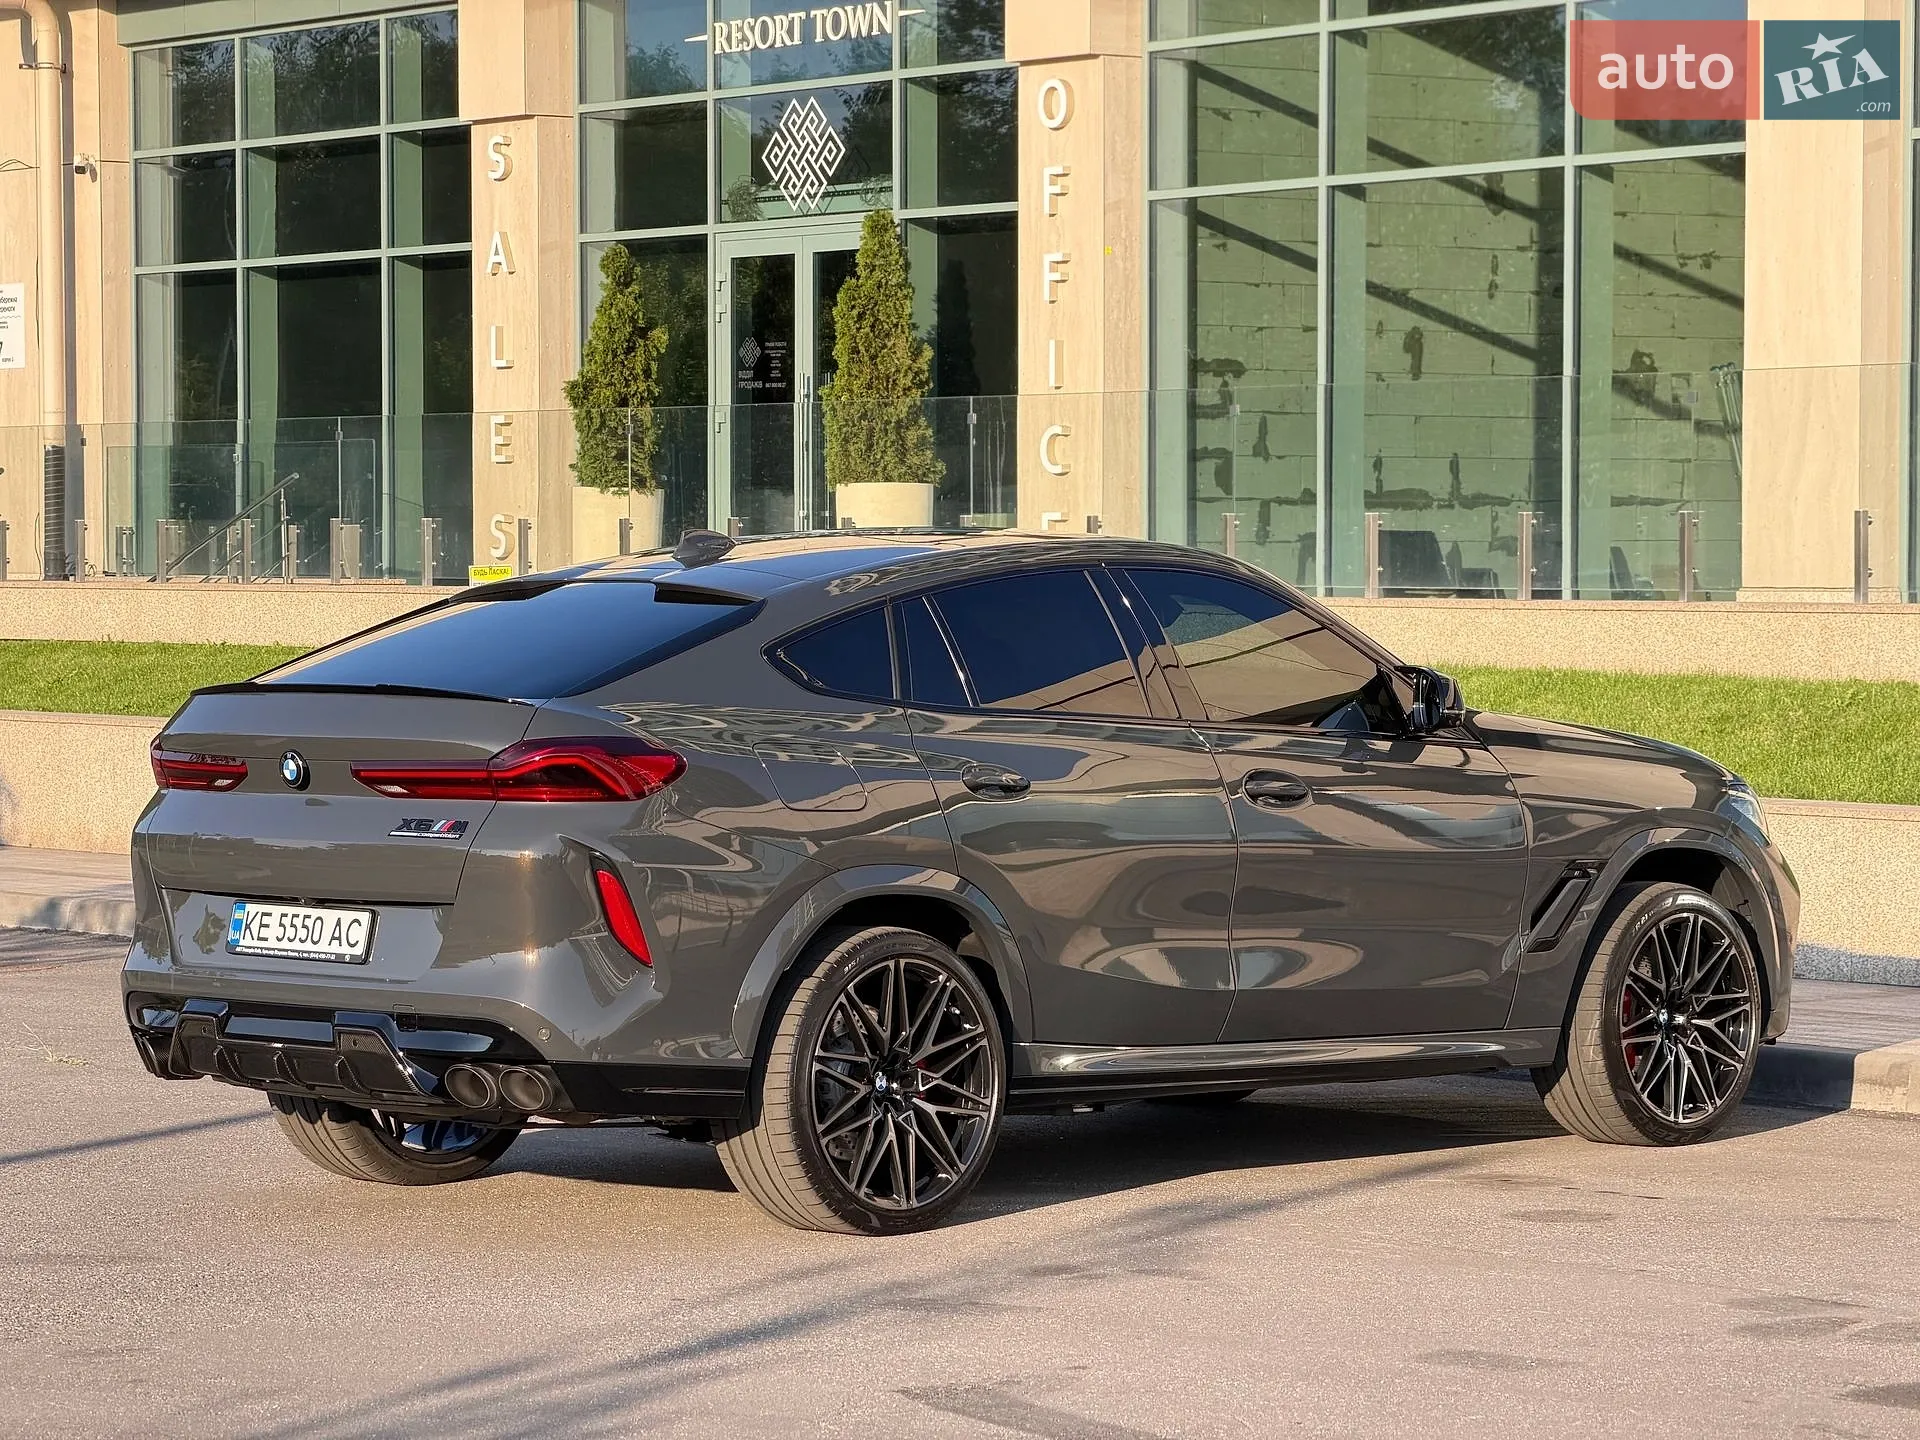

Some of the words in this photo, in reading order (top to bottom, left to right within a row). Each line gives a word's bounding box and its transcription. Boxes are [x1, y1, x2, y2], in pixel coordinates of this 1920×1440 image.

[713, 11, 806, 54] RESORT
[810, 0, 893, 43] TOWN
[487, 135, 514, 561] SALES
[231, 930, 241, 941] UA
[242, 910, 273, 942] KE
[275, 912, 324, 946] 5550
[328, 917, 362, 948] AC
